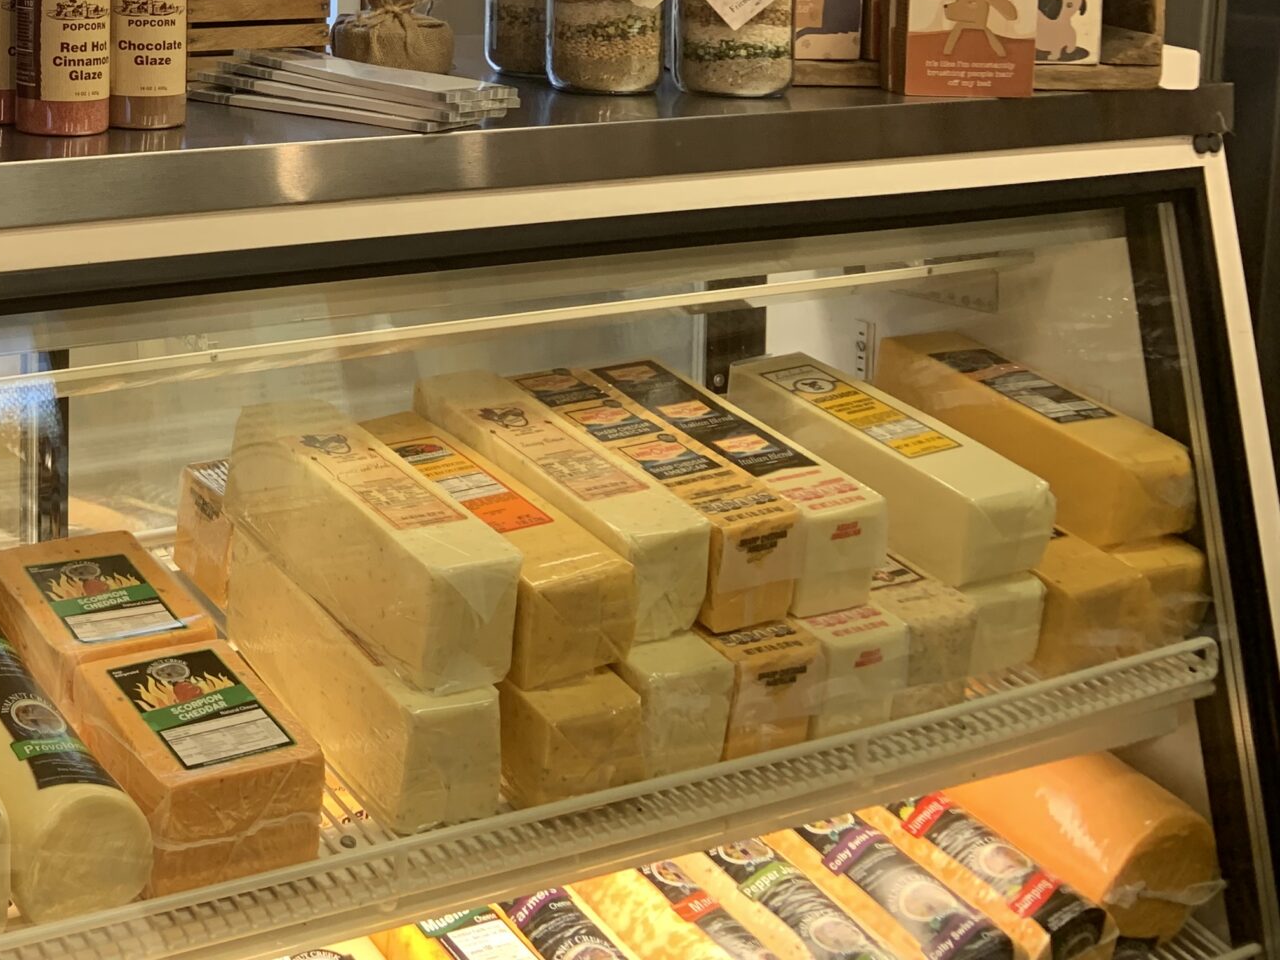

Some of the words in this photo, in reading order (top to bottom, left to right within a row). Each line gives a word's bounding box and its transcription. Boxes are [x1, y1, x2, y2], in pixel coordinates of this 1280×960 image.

[62, 23, 106, 31] POPCORN
[127, 19, 176, 28] POPCORN
[60, 42, 87, 53] Red
[91, 41, 107, 52] Hot
[118, 40, 183, 51] Chocolate
[134, 55, 172, 66] Glaze
[69, 70, 102, 81] Glaze
[738, 455, 769, 466] Italian
[770, 449, 793, 463] Blend
[171, 693, 223, 715] SCORPION
[178, 701, 227, 721] CHEDDAR
[829, 848, 852, 871] Colby
[744, 869, 780, 897] Pepper
[1015, 879, 1053, 915] Jumping
[929, 937, 954, 960] Colby
